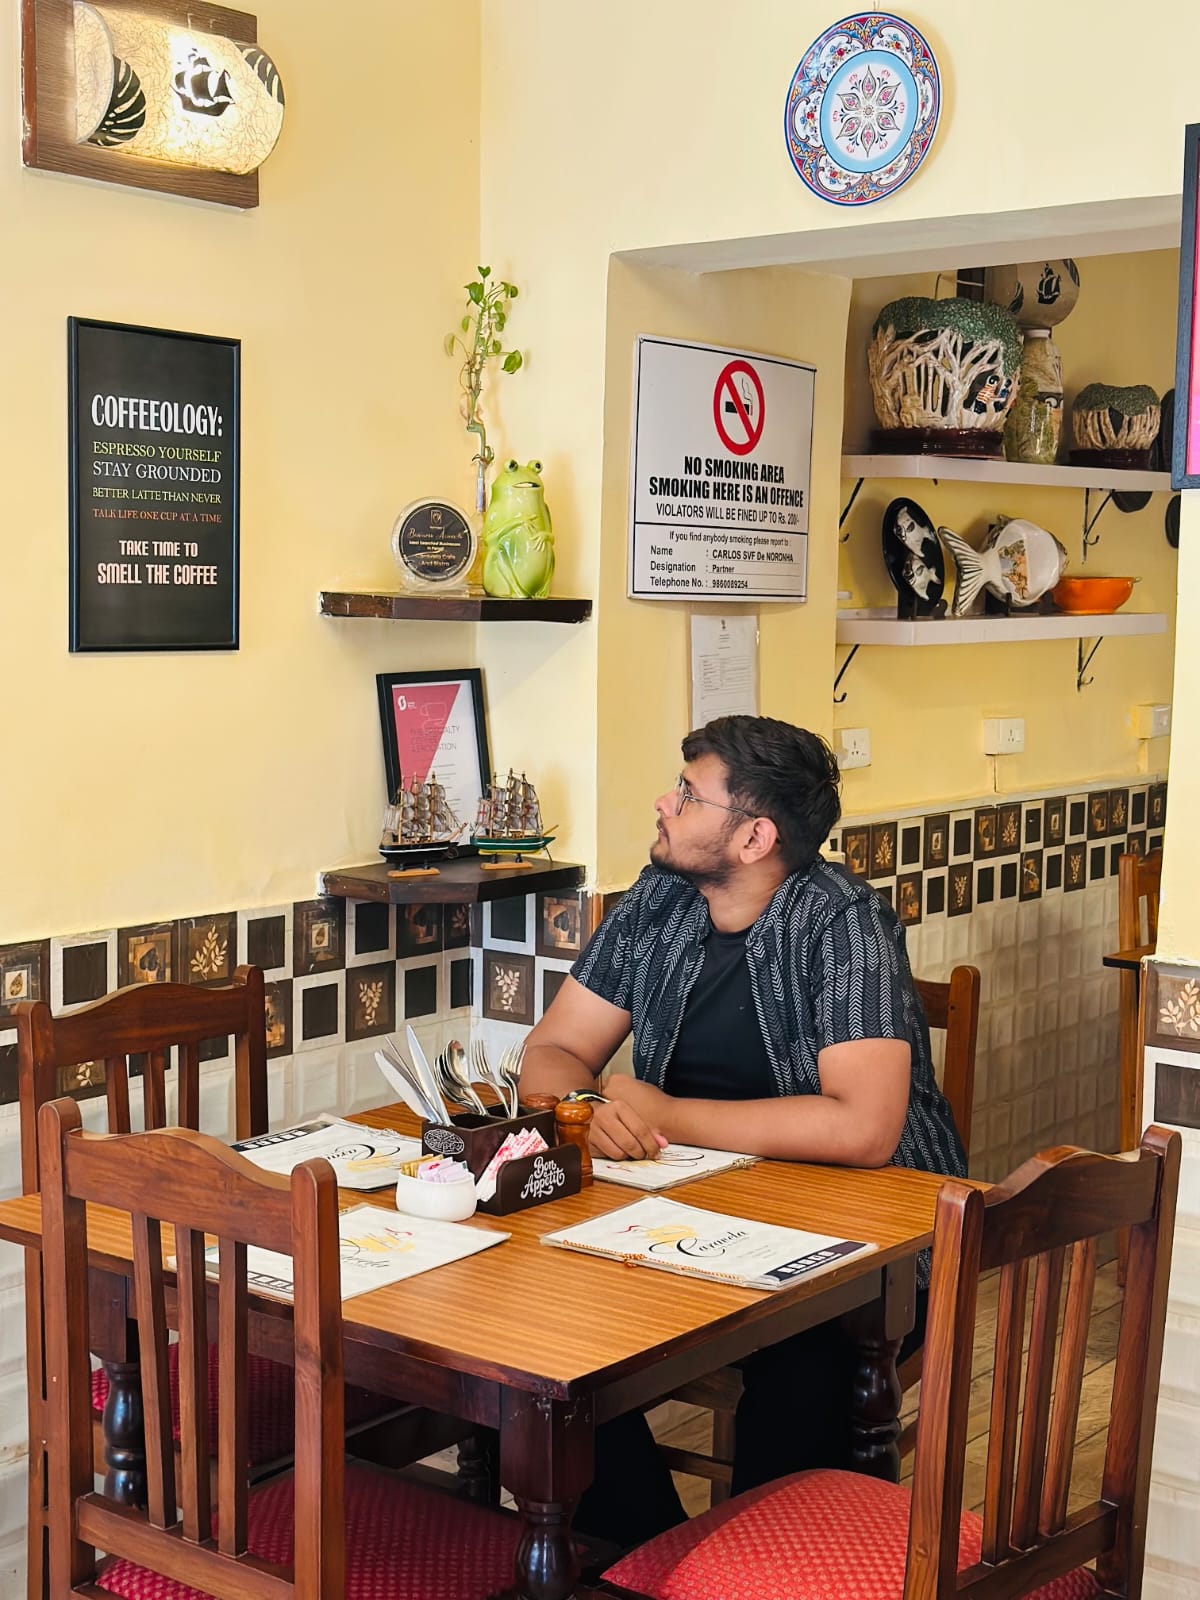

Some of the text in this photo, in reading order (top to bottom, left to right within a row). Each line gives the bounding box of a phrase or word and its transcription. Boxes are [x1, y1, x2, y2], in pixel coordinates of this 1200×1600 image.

[91, 394, 223, 437] COFFEEOLOGY:
[93, 441, 222, 463] ESPRESSO YOURSELF
[93, 460, 221, 484] STAY GROUNDED
[684, 455, 785, 484] NO SMOKING AREA
[92, 487, 222, 504] BETTER LATTE THAN NEVER
[649, 476, 804, 508] SMOKING HERE IS AN OFFENCE
[92, 508, 222, 524] TALK LIFE ONE CUP AT A TIME
[656, 502, 704, 518] VIOLATORS
[705, 506, 724, 520] WILL
[726, 507, 736, 521] BE
[737, 508, 758, 522] FINED
[758, 510, 768, 523] UP
[768, 511, 777, 524] TO
[778, 513, 787, 525] Rs.
[118, 540, 199, 557] TAKE TIME TO
[669, 531, 675, 540] If
[675, 532, 688, 541] you
[689, 531, 702, 542] find
[702, 533, 729, 545] anybody
[729, 535, 752, 547] smoking
[753, 536, 770, 547] please
[770, 537, 784, 547] report
[650, 545, 673, 556] Name
[712, 549, 742, 560] CARLOS
[742, 550, 756, 561] SVF
[756, 551, 766, 561] De
[766, 551, 794, 563] NORONHA
[97, 562, 218, 585] SMELL THE COFFEE
[650, 560, 696, 574] Designation
[712, 564, 735, 573] Partner
[650, 576, 690, 588] Telephone
[691, 577, 704, 588] No.
[533, 1156, 557, 1179] Bon
